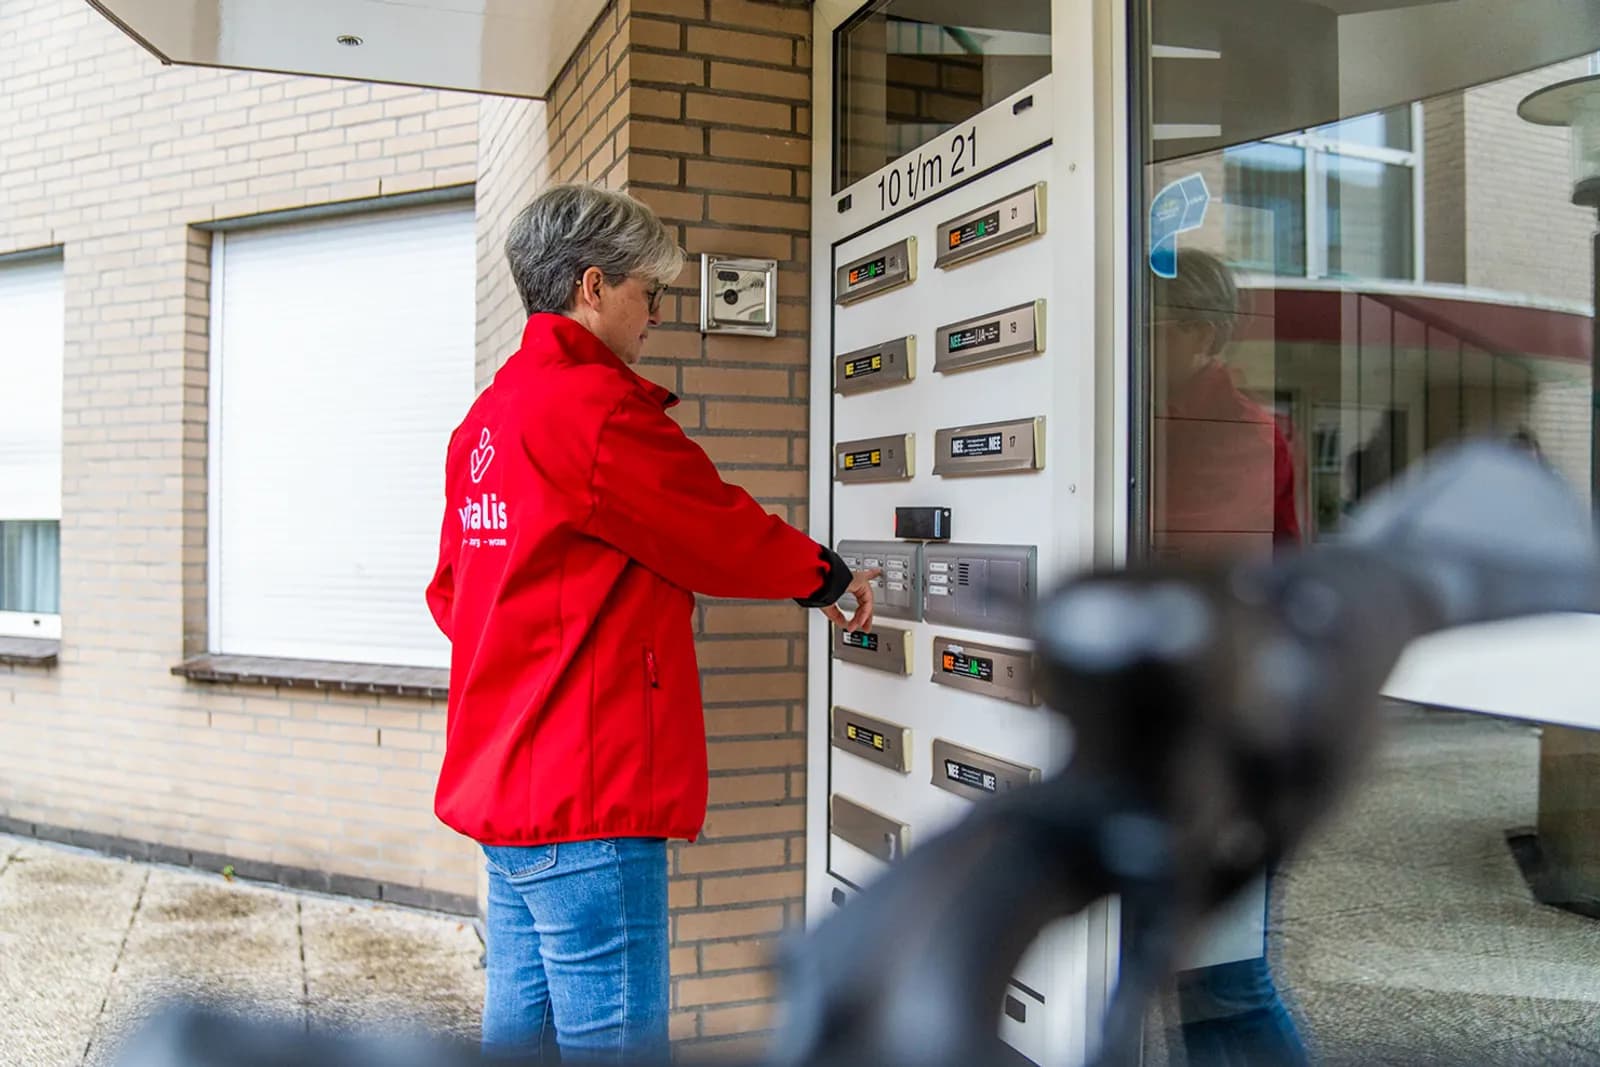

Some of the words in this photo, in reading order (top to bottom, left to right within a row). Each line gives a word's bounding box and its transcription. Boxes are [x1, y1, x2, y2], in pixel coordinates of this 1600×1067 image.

[878, 168, 901, 211] 10
[907, 153, 942, 200] t/m
[950, 126, 977, 178] 21
[952, 440, 964, 454] NEE
[988, 435, 1001, 450] NEE
[947, 762, 959, 778] NEE
[983, 774, 995, 791] NEE
